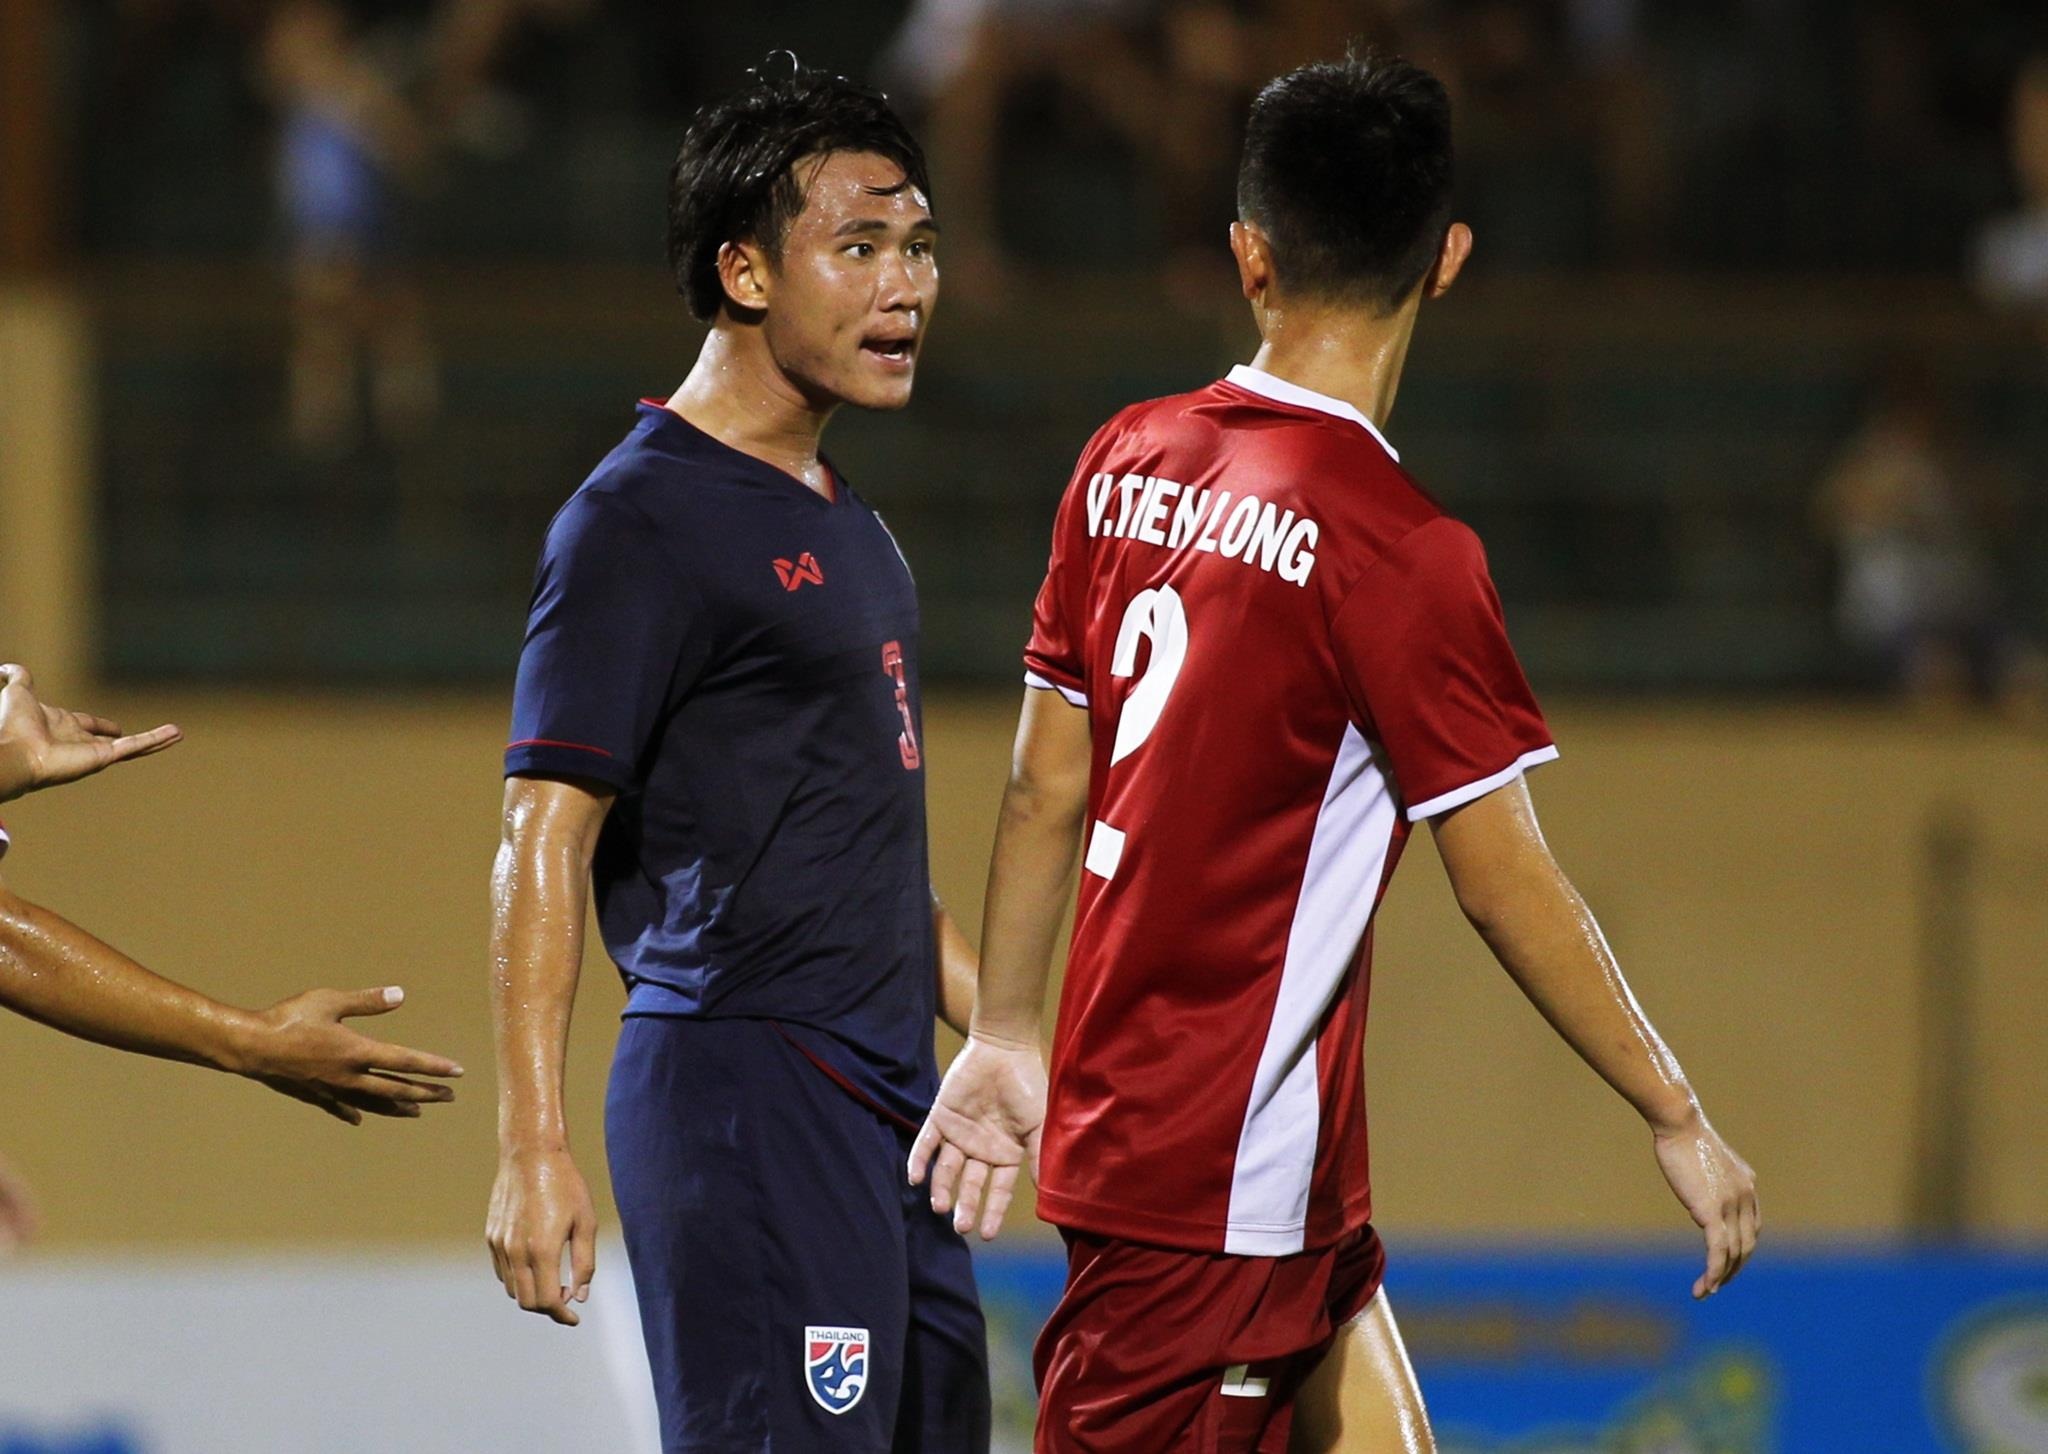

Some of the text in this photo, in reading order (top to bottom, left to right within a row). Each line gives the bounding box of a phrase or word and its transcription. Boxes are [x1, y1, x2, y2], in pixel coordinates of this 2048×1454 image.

[1196, 489, 1319, 588] LONG
[882, 640, 920, 770] 3
[809, 1330, 865, 1342] THAILAND
